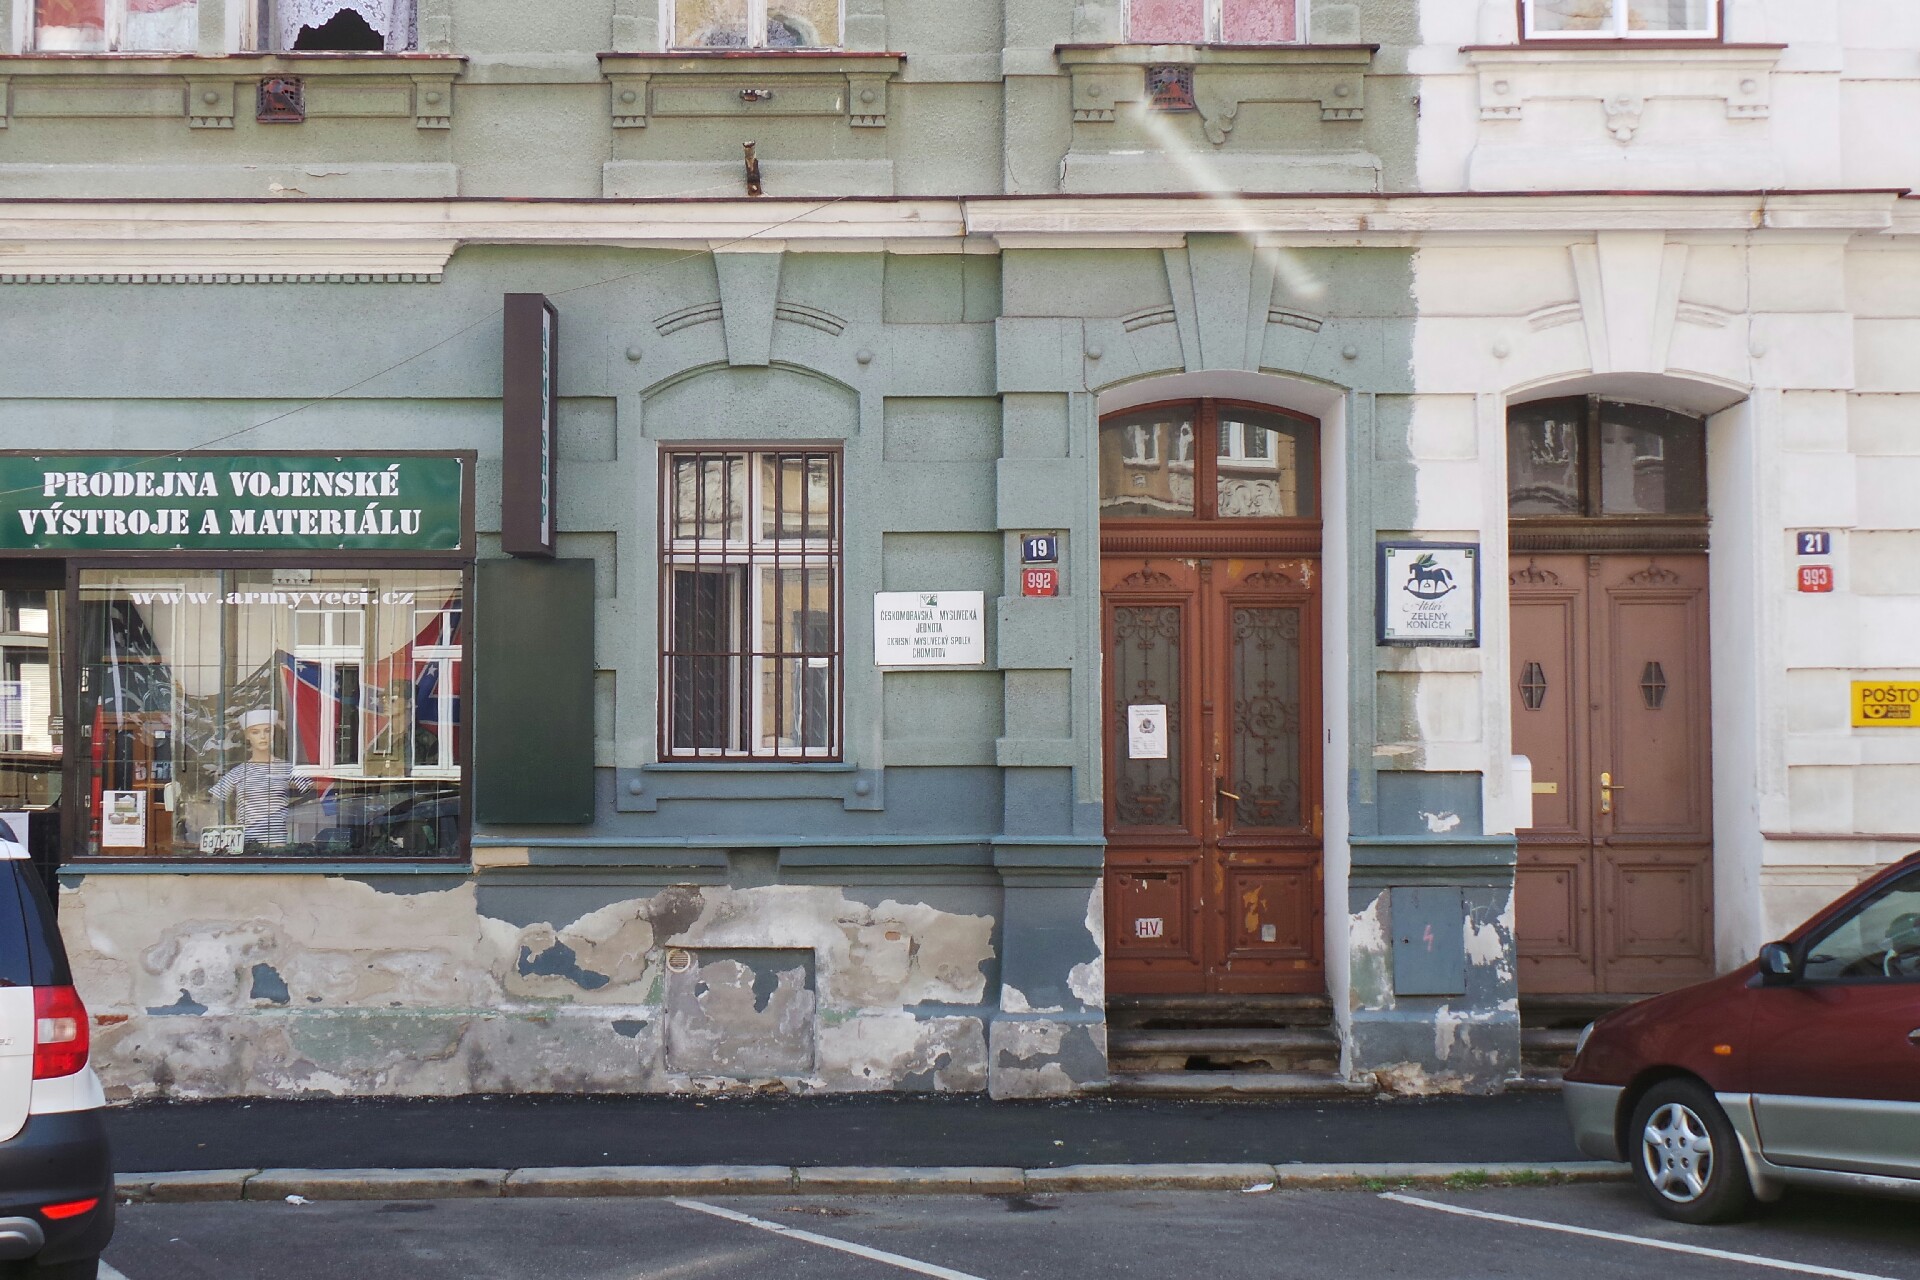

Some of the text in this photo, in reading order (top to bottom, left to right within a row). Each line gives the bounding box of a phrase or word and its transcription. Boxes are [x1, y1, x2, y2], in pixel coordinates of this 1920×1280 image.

[43, 464, 400, 497] PRODEJNA VOJENSKÉ
[18, 502, 422, 535] VÝSTROJE A MATERIÁLU
[1030, 539, 1048, 557] 19
[1805, 533, 1822, 552] 21
[1027, 572, 1051, 589] 992
[1803, 569, 1828, 585] 993
[130, 587, 415, 609] www.armyveci.cz
[880, 608, 978, 621] ČESKOMORAVSKÁ MYSLIVECKÁ
[915, 622, 943, 634] JEDNOTA
[912, 647, 946, 659] CHOMUTOV
[1862, 685, 1920, 703] POŠTO
